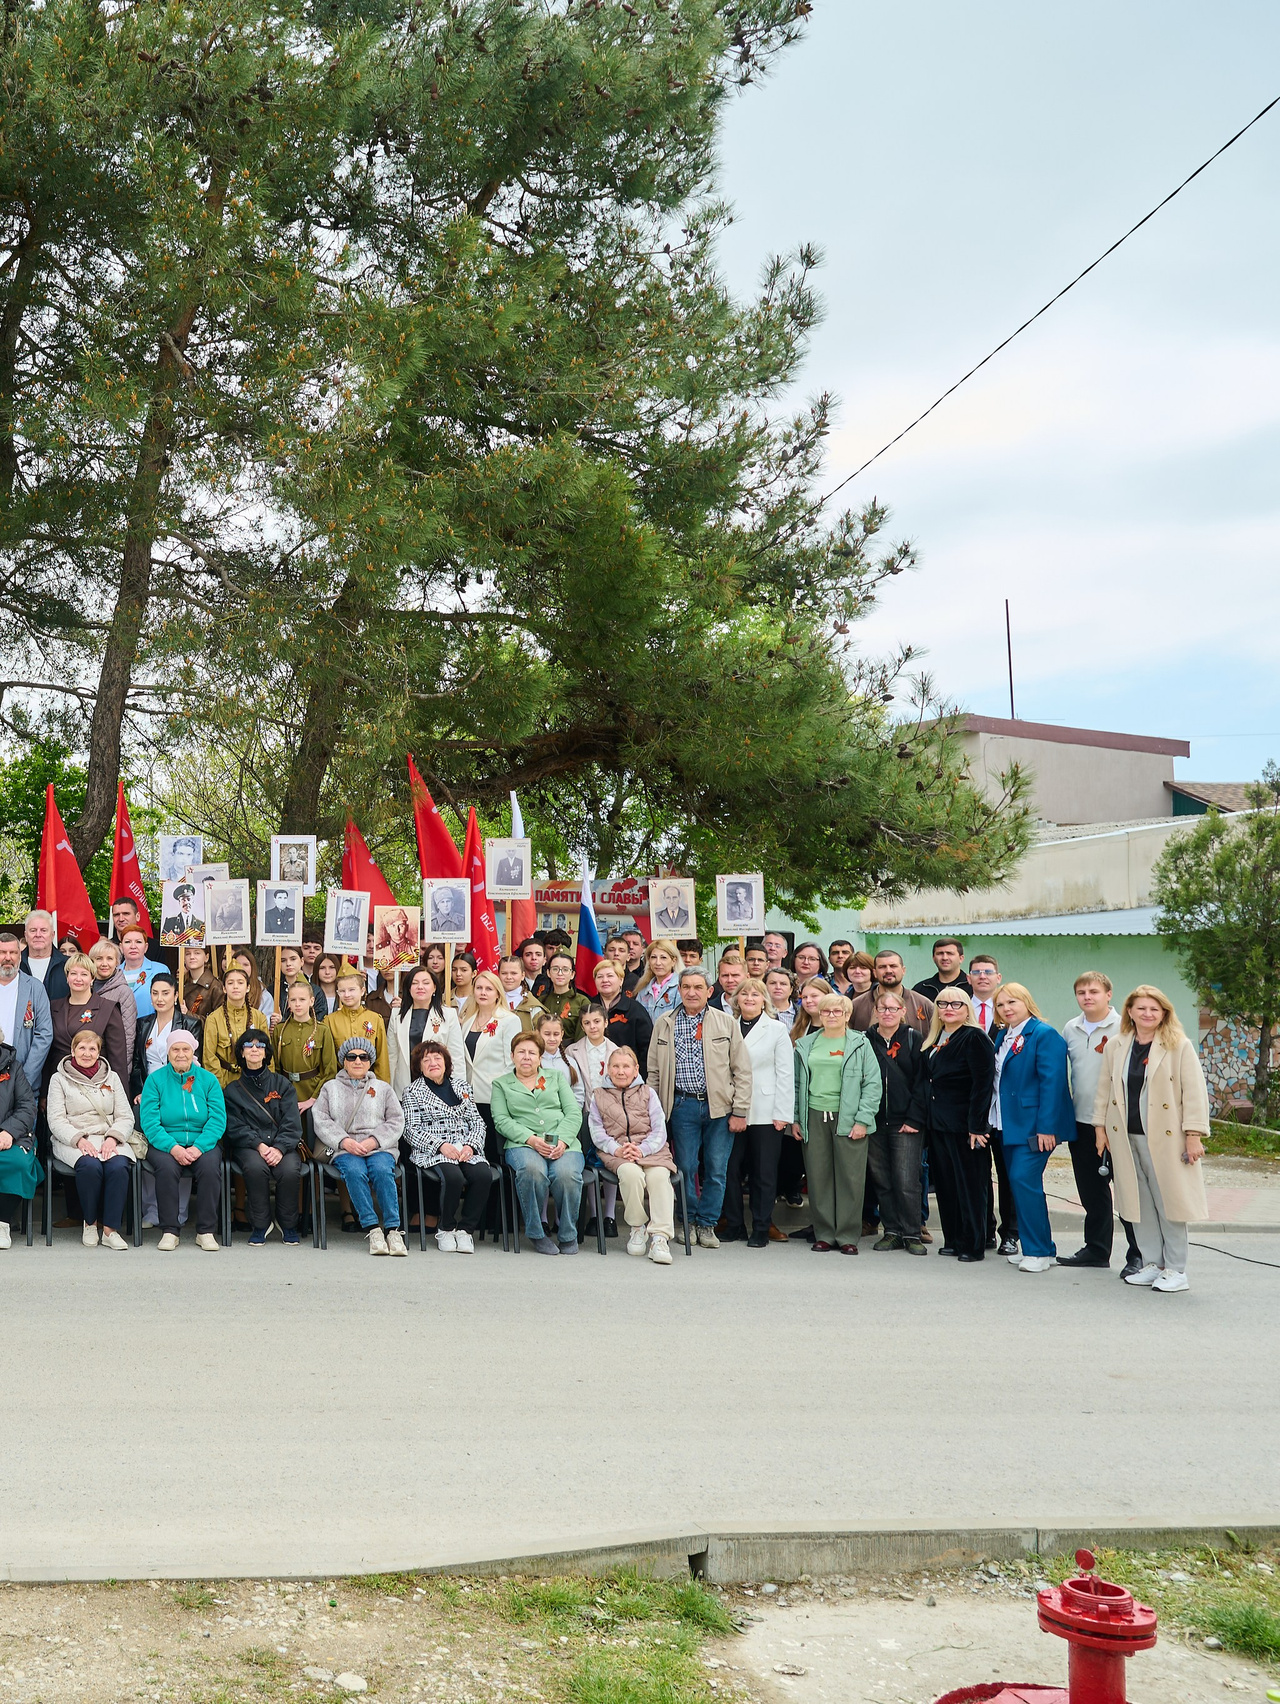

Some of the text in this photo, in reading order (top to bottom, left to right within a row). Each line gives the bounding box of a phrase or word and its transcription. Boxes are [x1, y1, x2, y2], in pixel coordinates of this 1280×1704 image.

[128, 881, 150, 912] ИДРИЦ
[535, 890, 582, 903] ПАМЯТИ
[600, 892, 644, 904] СЛАВЫ
